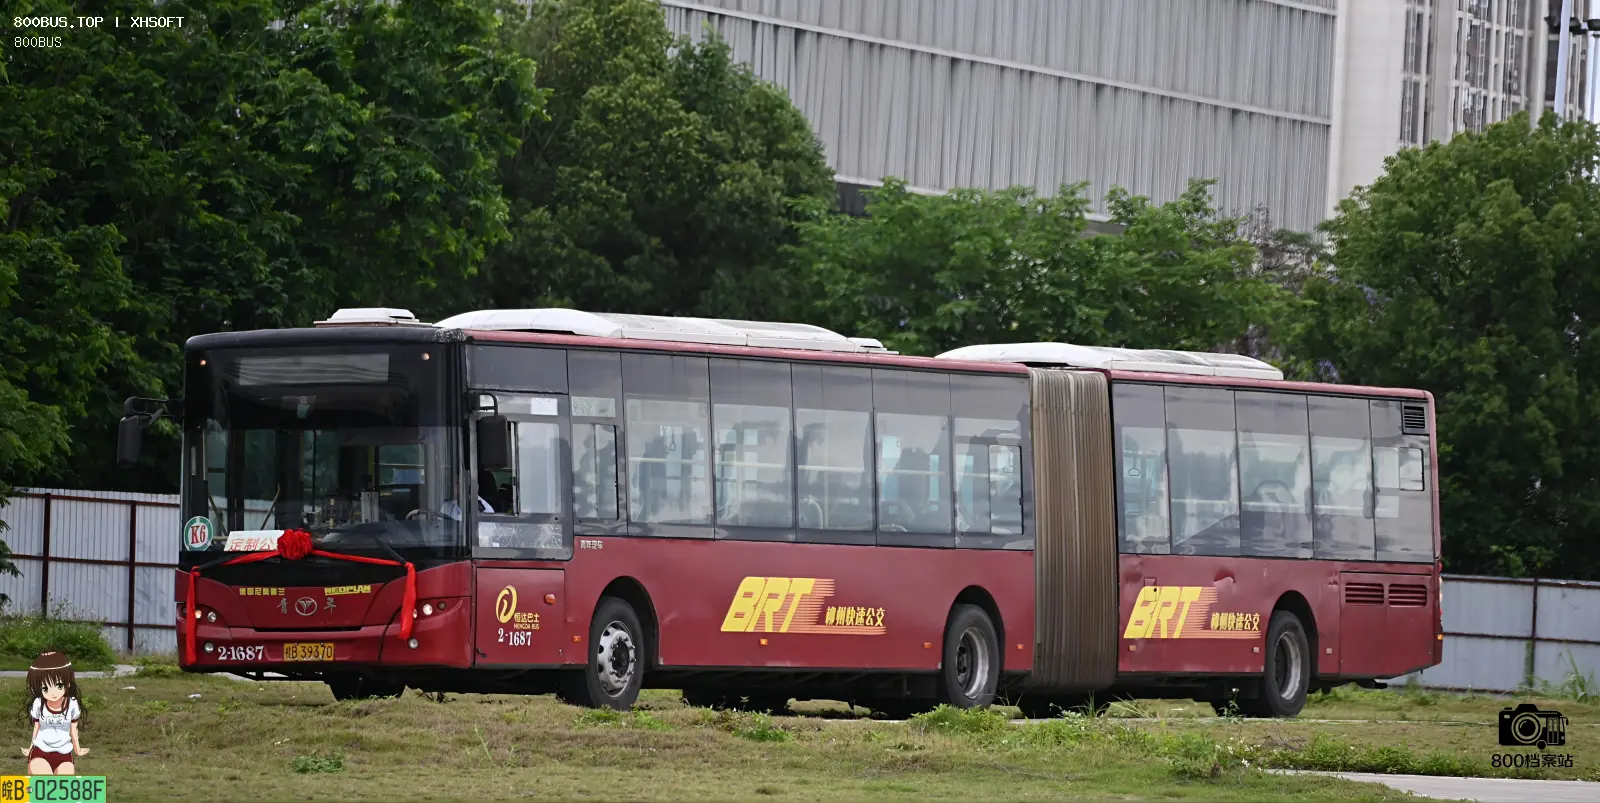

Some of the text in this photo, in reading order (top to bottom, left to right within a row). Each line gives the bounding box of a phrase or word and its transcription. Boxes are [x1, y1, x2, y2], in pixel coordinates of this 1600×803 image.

[191, 525, 206, 544] K6
[229, 537, 278, 551] 定制公
[324, 585, 371, 595] NEOPLAN
[720, 576, 816, 632] BRT
[1123, 586, 1203, 638] BRT
[513, 612, 540, 623] 恒达巴士
[825, 606, 886, 627] 柳州快速公交
[1211, 612, 1261, 631] 柳州快速公交
